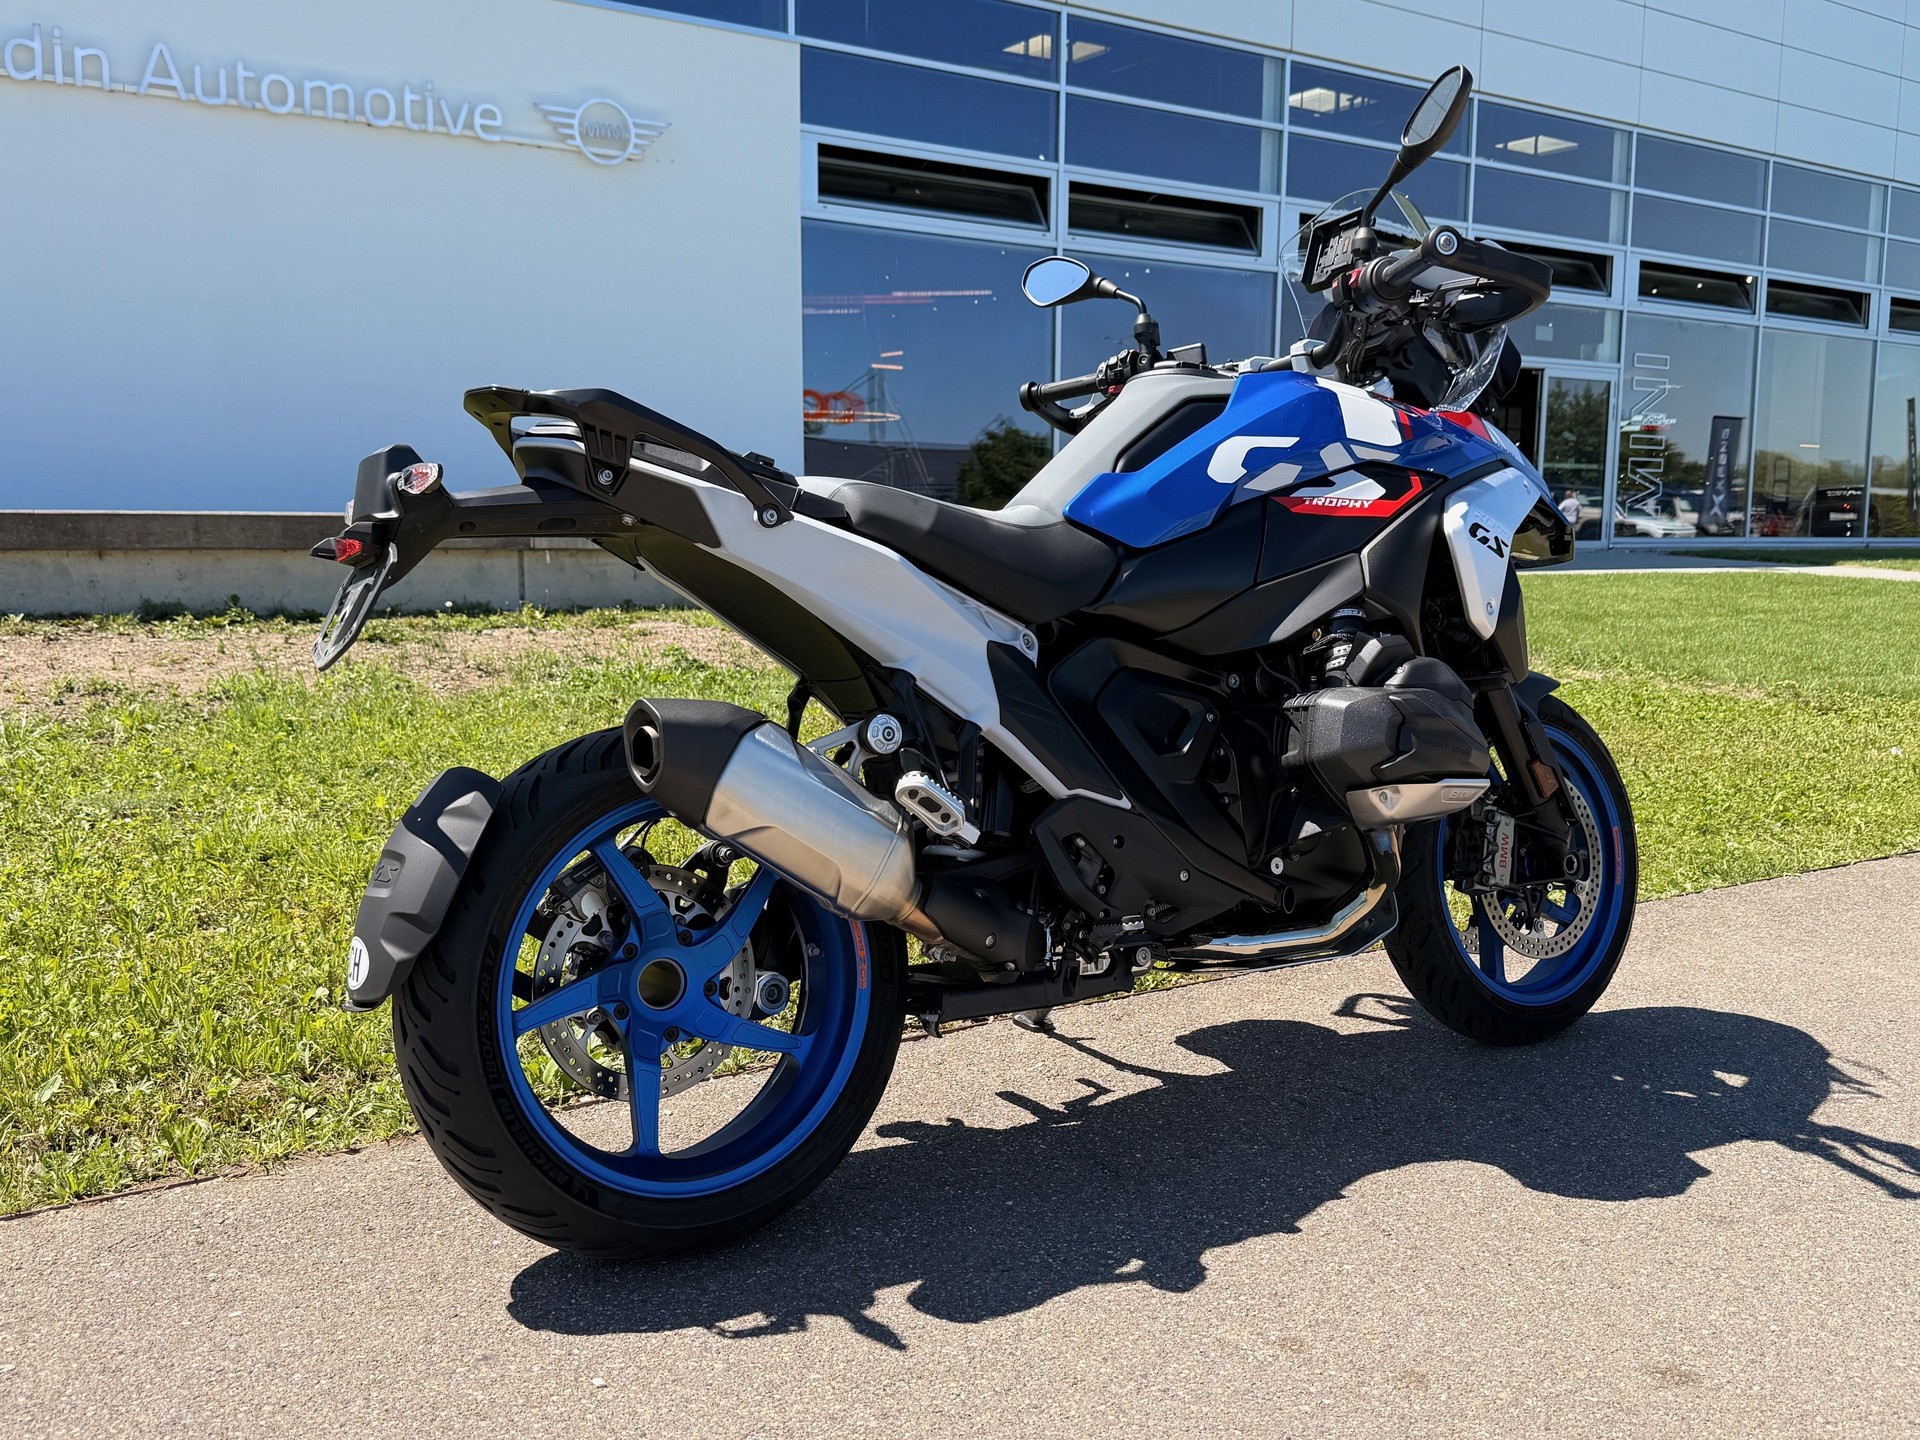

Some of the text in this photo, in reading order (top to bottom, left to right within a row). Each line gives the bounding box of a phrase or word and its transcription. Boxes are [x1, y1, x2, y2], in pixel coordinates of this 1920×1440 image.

[137, 42, 503, 143] Automotive
[583, 120, 626, 140] MINI
[1303, 497, 1373, 508] TROPHY
[1468, 521, 1509, 559] GS
[1449, 790, 1475, 799] BMW
[1500, 832, 1510, 869] BMW
[479, 943, 500, 1083] 180/55 ZR 17
[497, 1097, 570, 1184] MICHELIN
